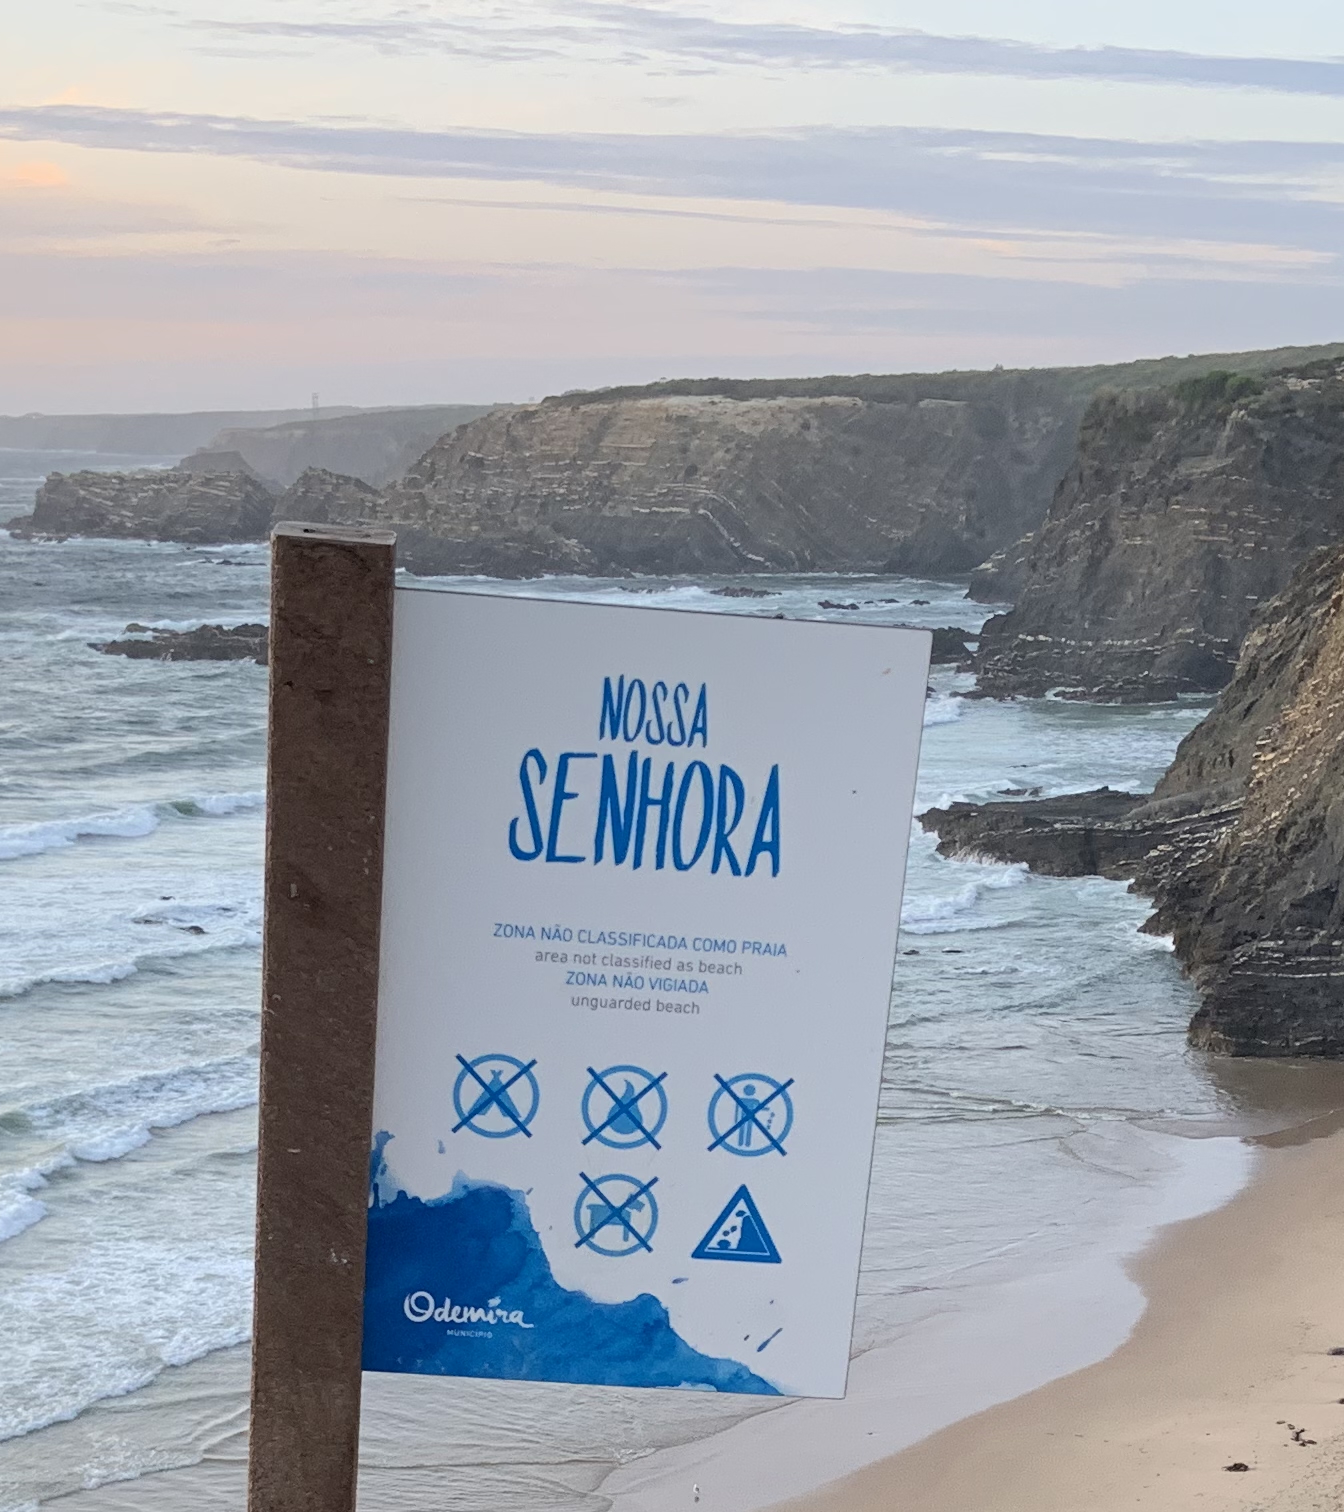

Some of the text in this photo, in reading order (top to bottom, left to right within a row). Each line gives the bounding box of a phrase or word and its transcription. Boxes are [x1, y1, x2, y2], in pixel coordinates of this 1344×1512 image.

[599, 675, 707, 747] NOSSA
[508, 749, 781, 877] SENHORA
[493, 923, 788, 957] ZONA NÃO CLASSIFICADA COMO PRAIA
[535, 951, 743, 975] area not classified as beach
[565, 971, 709, 994] ZONA NÃO VIGIADA
[571, 996, 700, 1015] unguarded beach
[403, 1291, 534, 1328] Odemira
